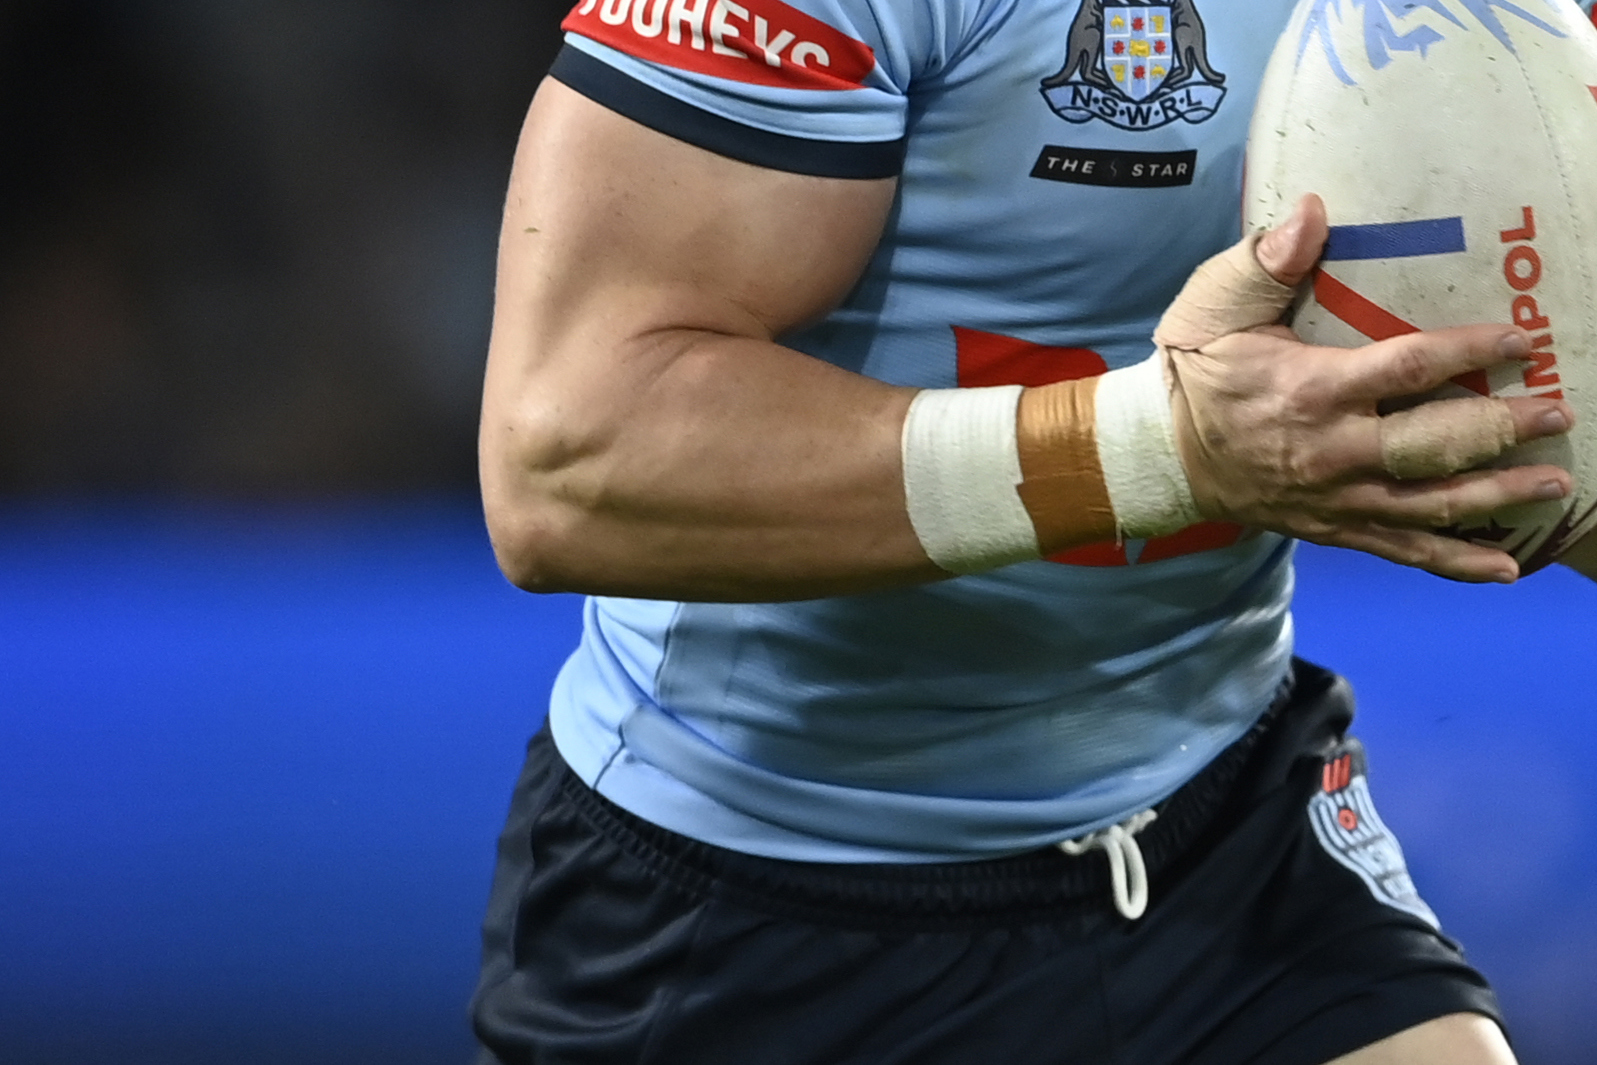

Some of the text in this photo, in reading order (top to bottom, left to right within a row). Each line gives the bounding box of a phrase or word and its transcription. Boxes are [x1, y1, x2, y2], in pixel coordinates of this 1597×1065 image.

[1046, 156, 1188, 178] THE STAR
[1500, 205, 1563, 400] MPOL
